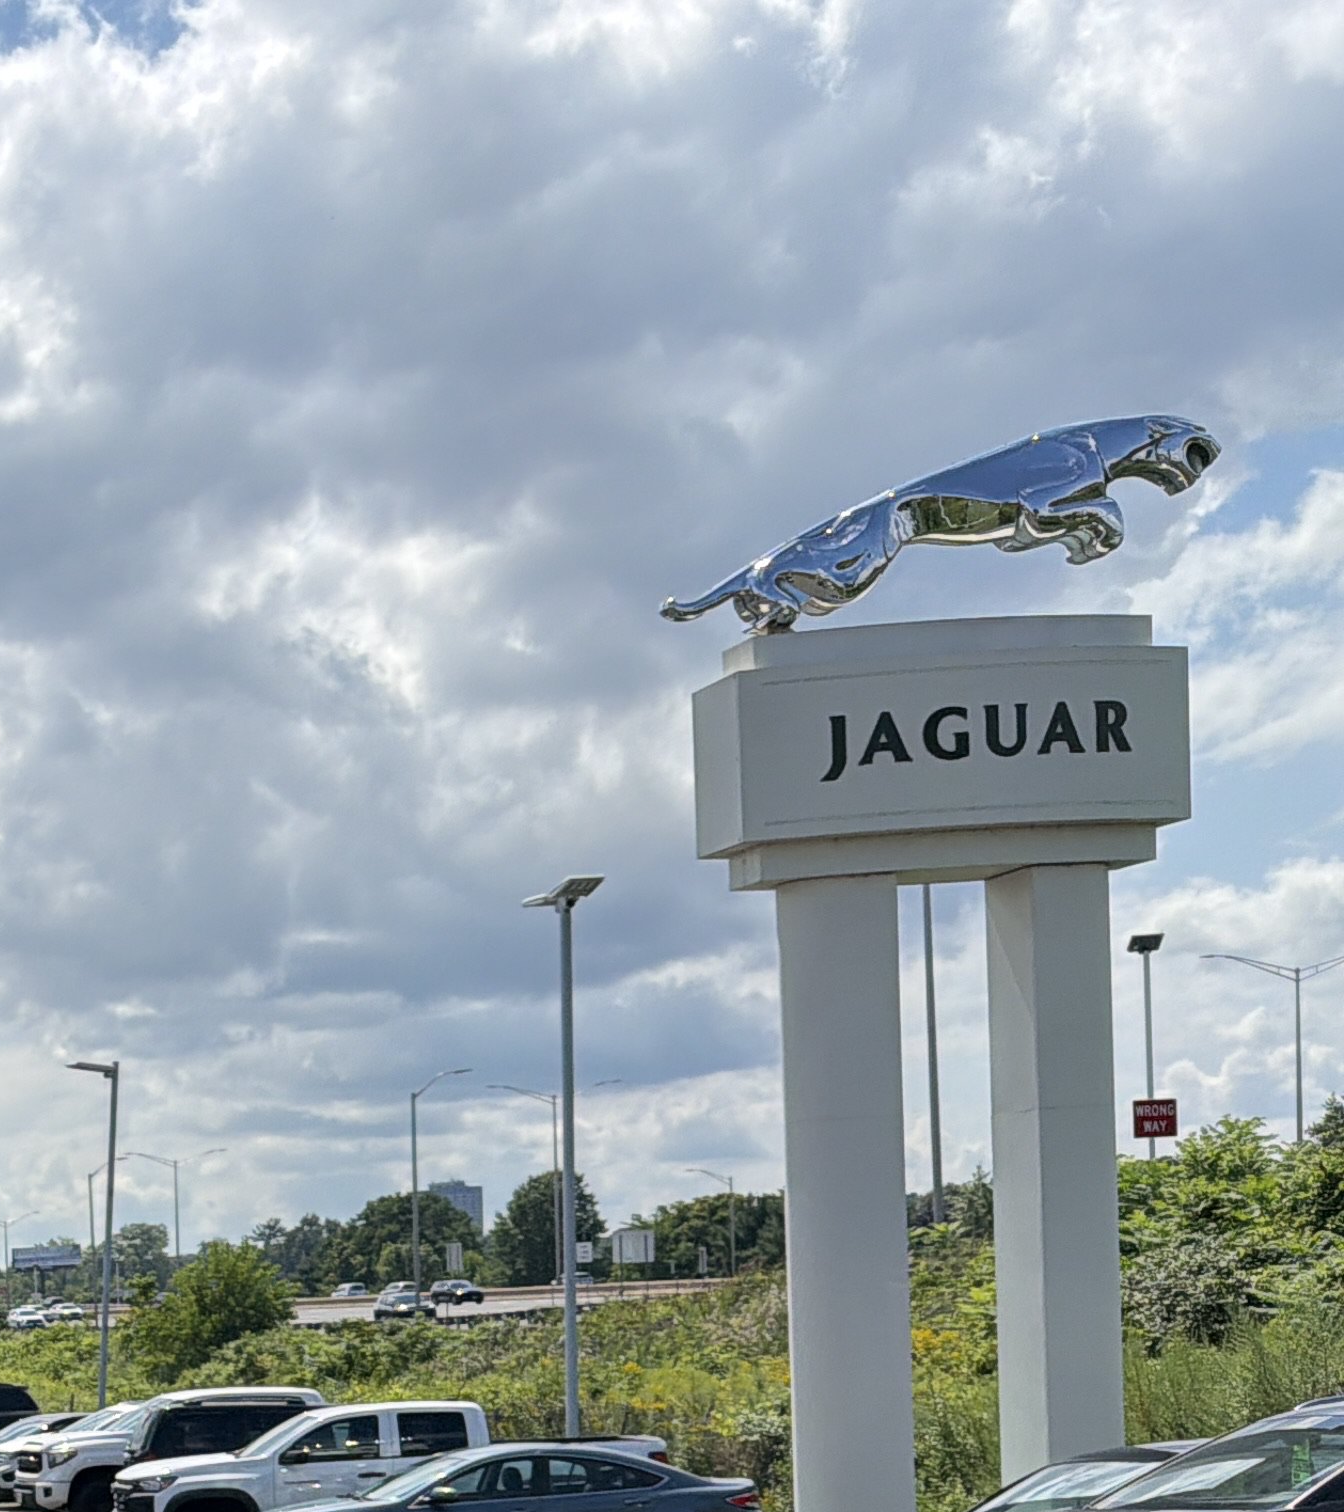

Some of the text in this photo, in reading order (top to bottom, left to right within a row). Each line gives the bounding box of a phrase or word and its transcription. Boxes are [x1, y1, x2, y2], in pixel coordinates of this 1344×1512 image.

[819, 699, 1133, 783] JAGUAR
[1135, 1104, 1175, 1117] WRONG
[1143, 1120, 1168, 1133] WAY
